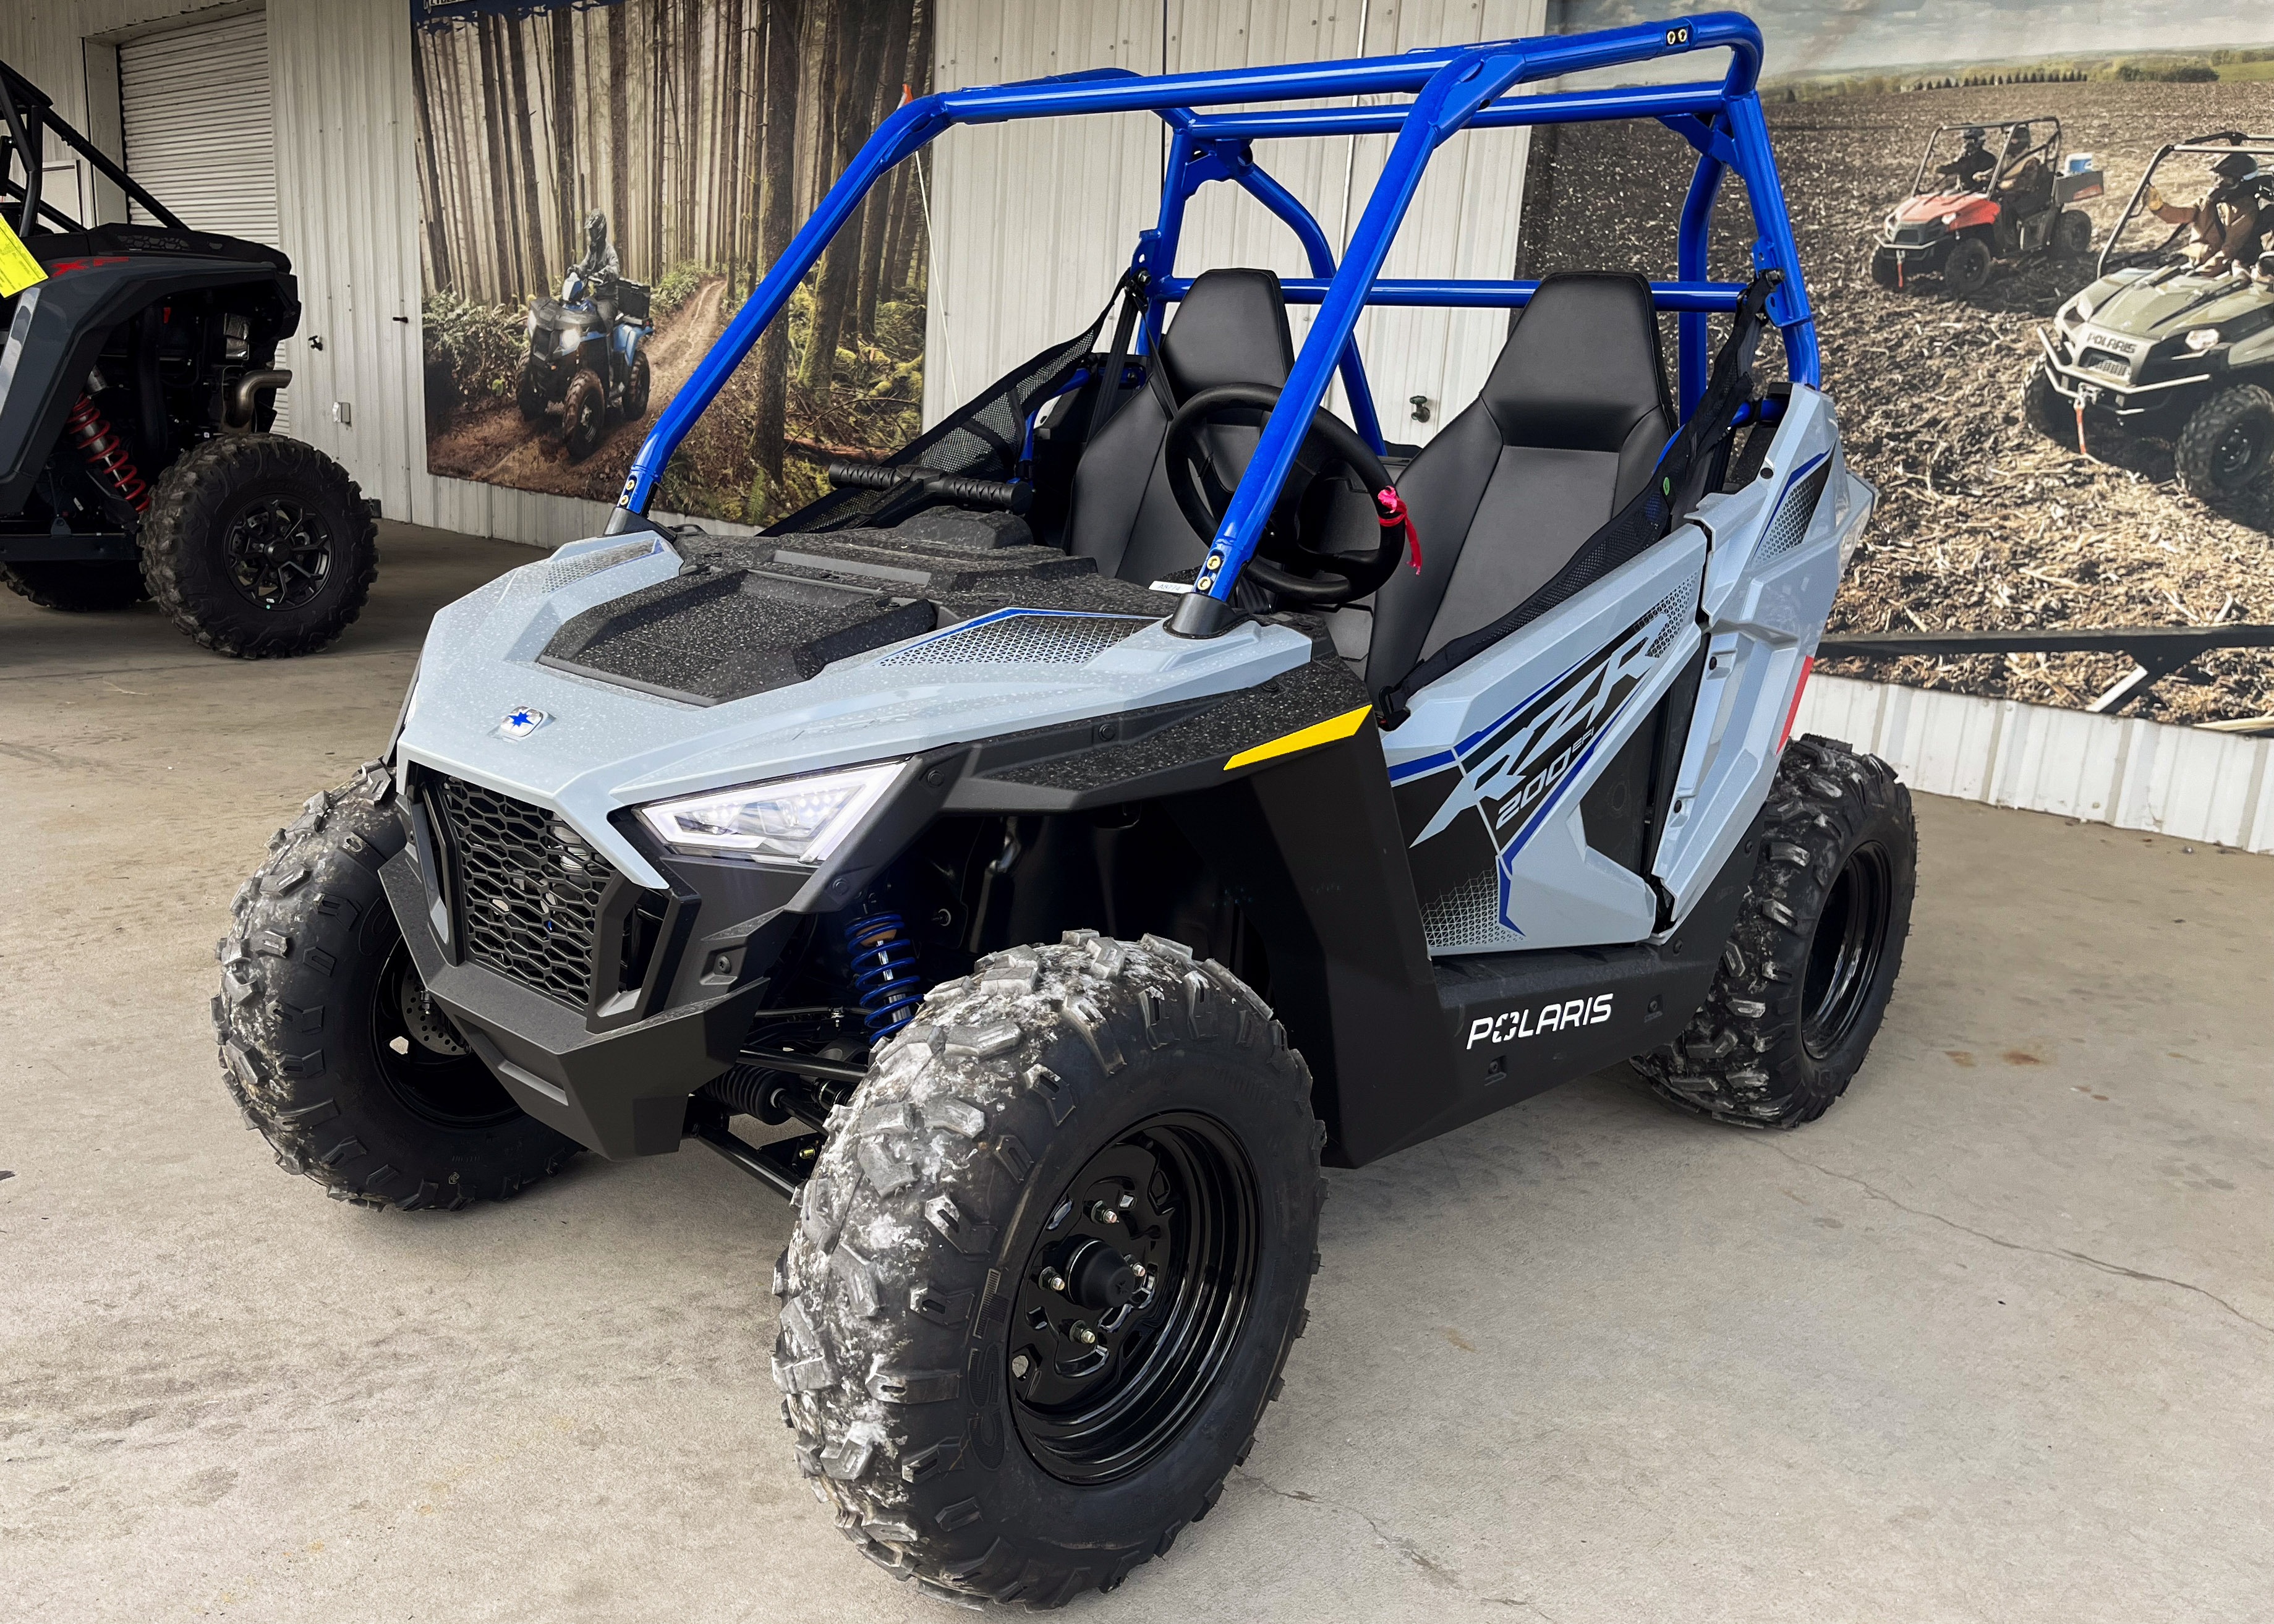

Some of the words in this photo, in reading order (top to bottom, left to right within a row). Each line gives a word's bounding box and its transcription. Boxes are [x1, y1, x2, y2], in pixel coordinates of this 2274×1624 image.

[2087, 333, 2138, 354] POLARIS
[1408, 612, 1670, 849] RZR
[1495, 746, 1572, 830] 200
[1466, 993, 1614, 1050] POLARIS
[968, 1268, 1010, 1471] CST
